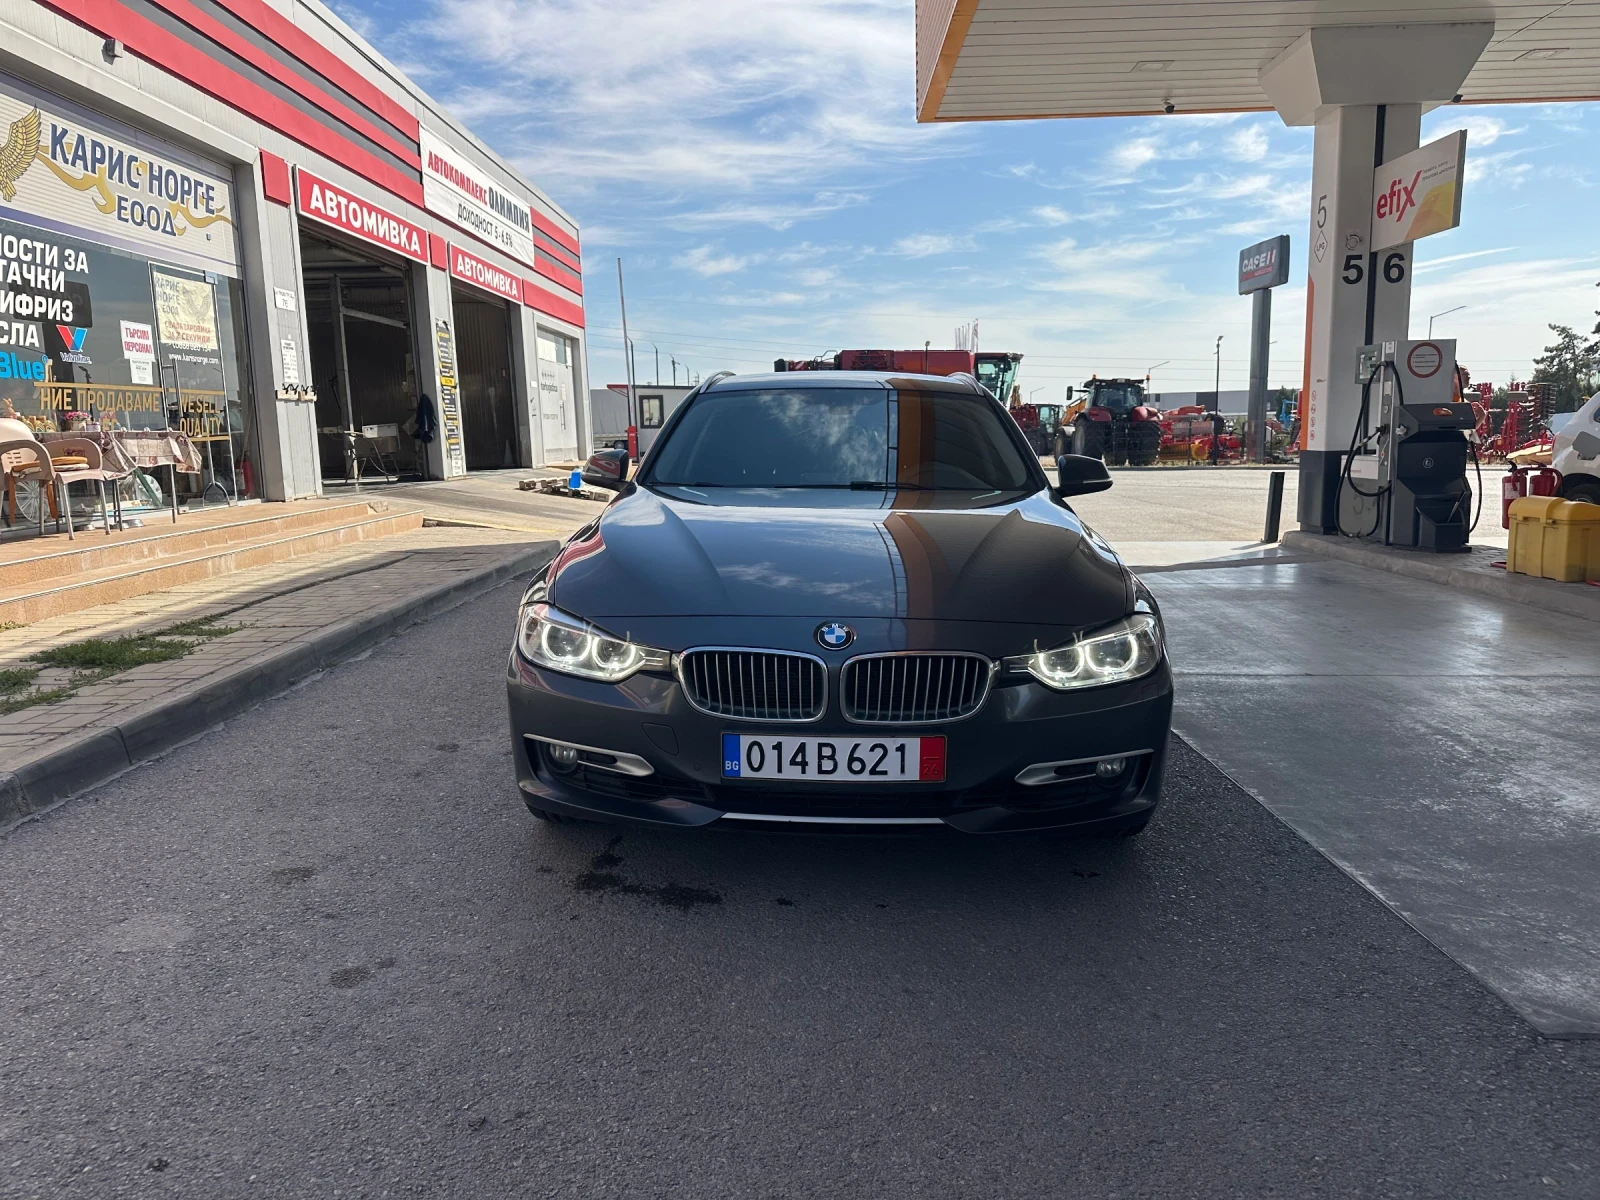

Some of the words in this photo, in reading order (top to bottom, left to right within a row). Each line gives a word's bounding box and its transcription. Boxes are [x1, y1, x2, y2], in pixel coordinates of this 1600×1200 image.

[50, 123, 140, 189] КАРИС
[149, 161, 215, 215] НОРГЕ
[428, 150, 488, 206] АВТОКОМПЛЕКС
[488, 186, 530, 233] ОЛИМПИЯ
[1376, 170, 1422, 222] efix
[117, 195, 176, 237] ЕООД
[310, 184, 422, 256] АВТОМИВКА
[458, 203, 493, 237] ДОХОДНОСТ
[1317, 194, 1327, 229] 5
[0, 233, 58, 268] ОСТИ
[64, 248, 89, 274] ЗА
[1316, 242, 1325, 251] LPG
[456, 253, 518, 298] АВТОМИВКА
[1242, 253, 1266, 273] CASE
[1342, 254, 1363, 285] 5
[1383, 252, 1405, 284] 6
[0, 289, 73, 322] ИФРИЗ
[0, 320, 40, 348] СЛА
[124, 341, 153, 354] ПЕРСОНАЛ
[40, 388, 72, 411] НИЕ
[77, 390, 160, 412] ПРОДАВАМЕ
[196, 395, 221, 414] SELL
[179, 418, 222, 437] QUALITY
[821, 623, 850, 631] BMW
[725, 760, 739, 771] BG
